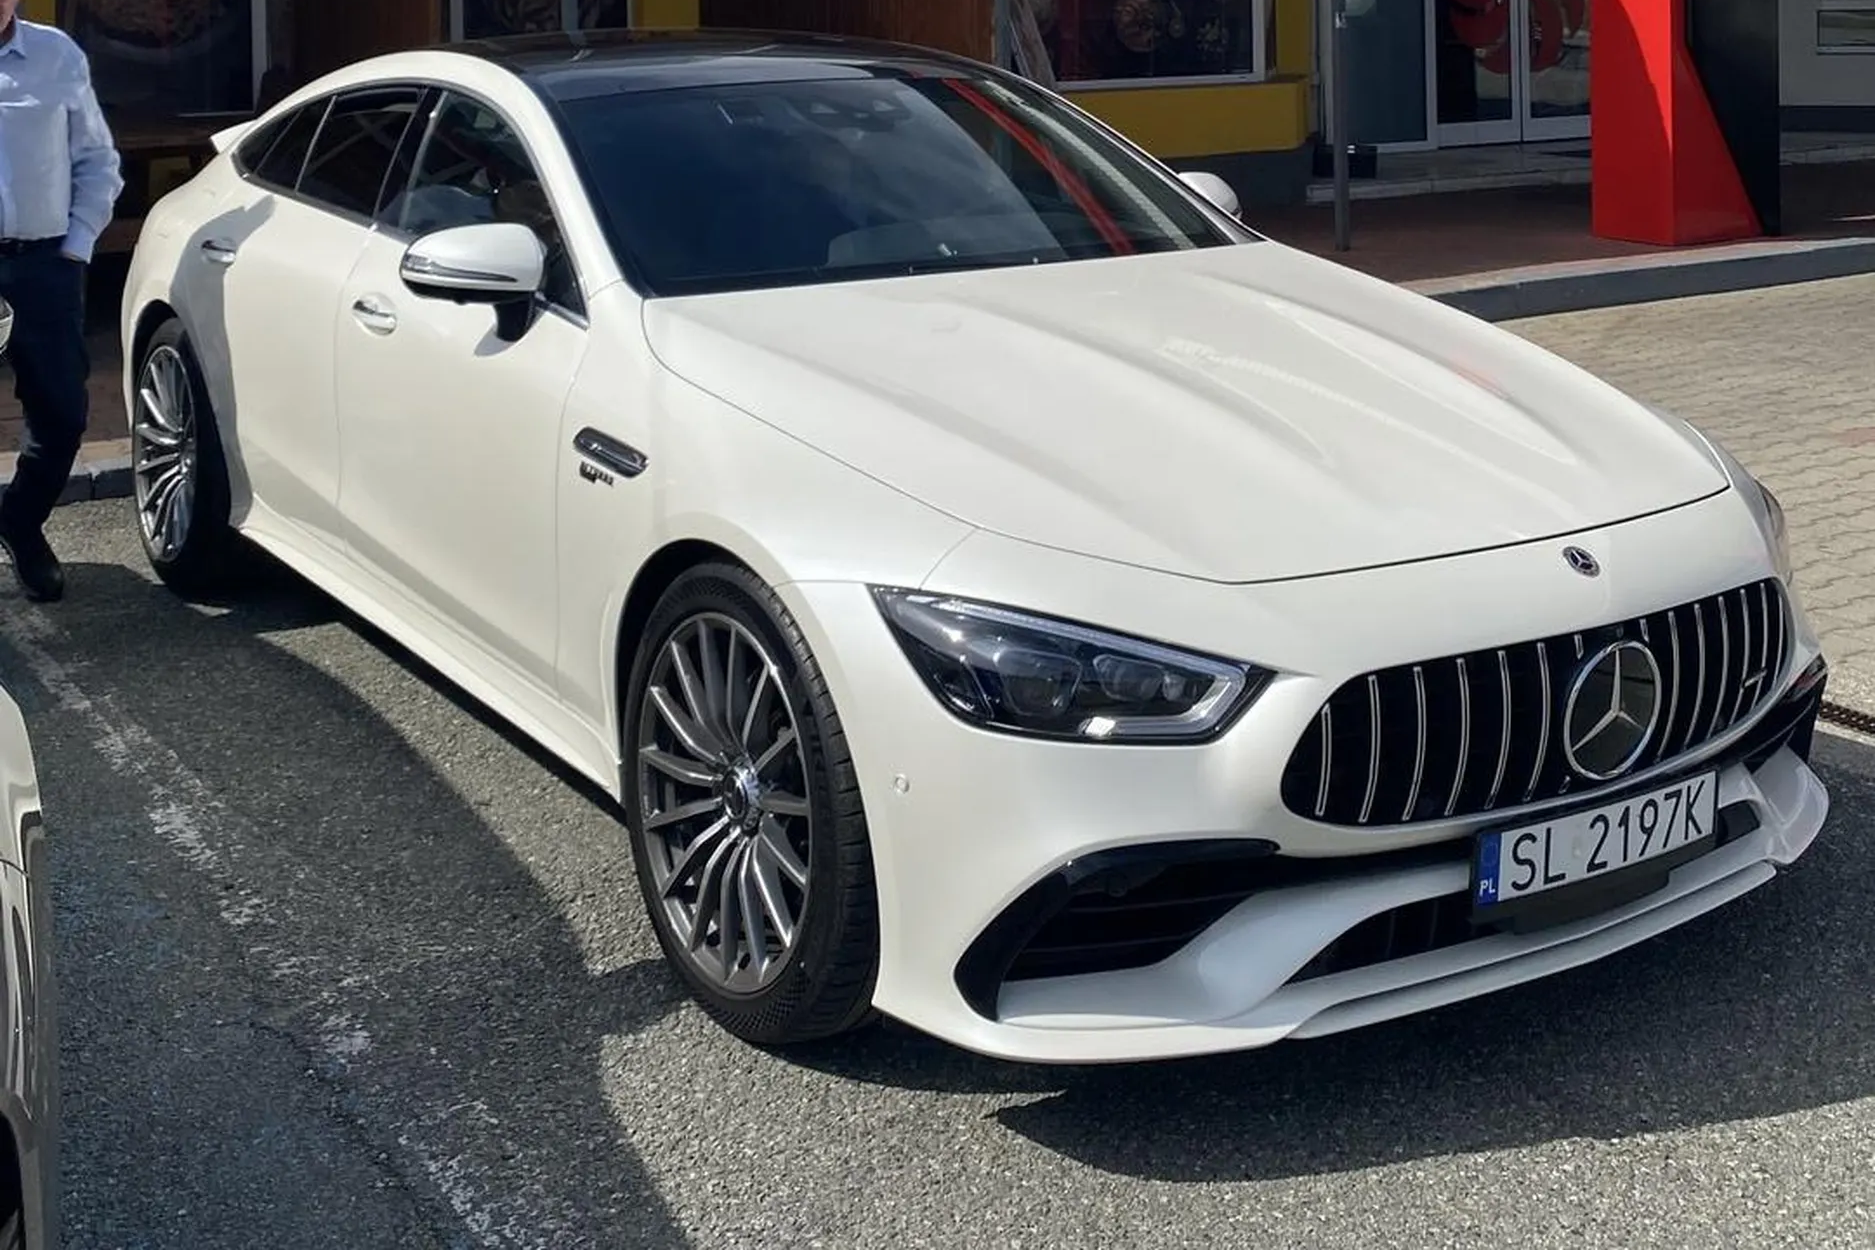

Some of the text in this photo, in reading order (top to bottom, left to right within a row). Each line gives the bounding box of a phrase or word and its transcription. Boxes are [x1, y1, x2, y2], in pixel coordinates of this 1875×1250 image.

[1511, 779, 1706, 891] SL 2197K
[1479, 878, 1496, 896] PL
